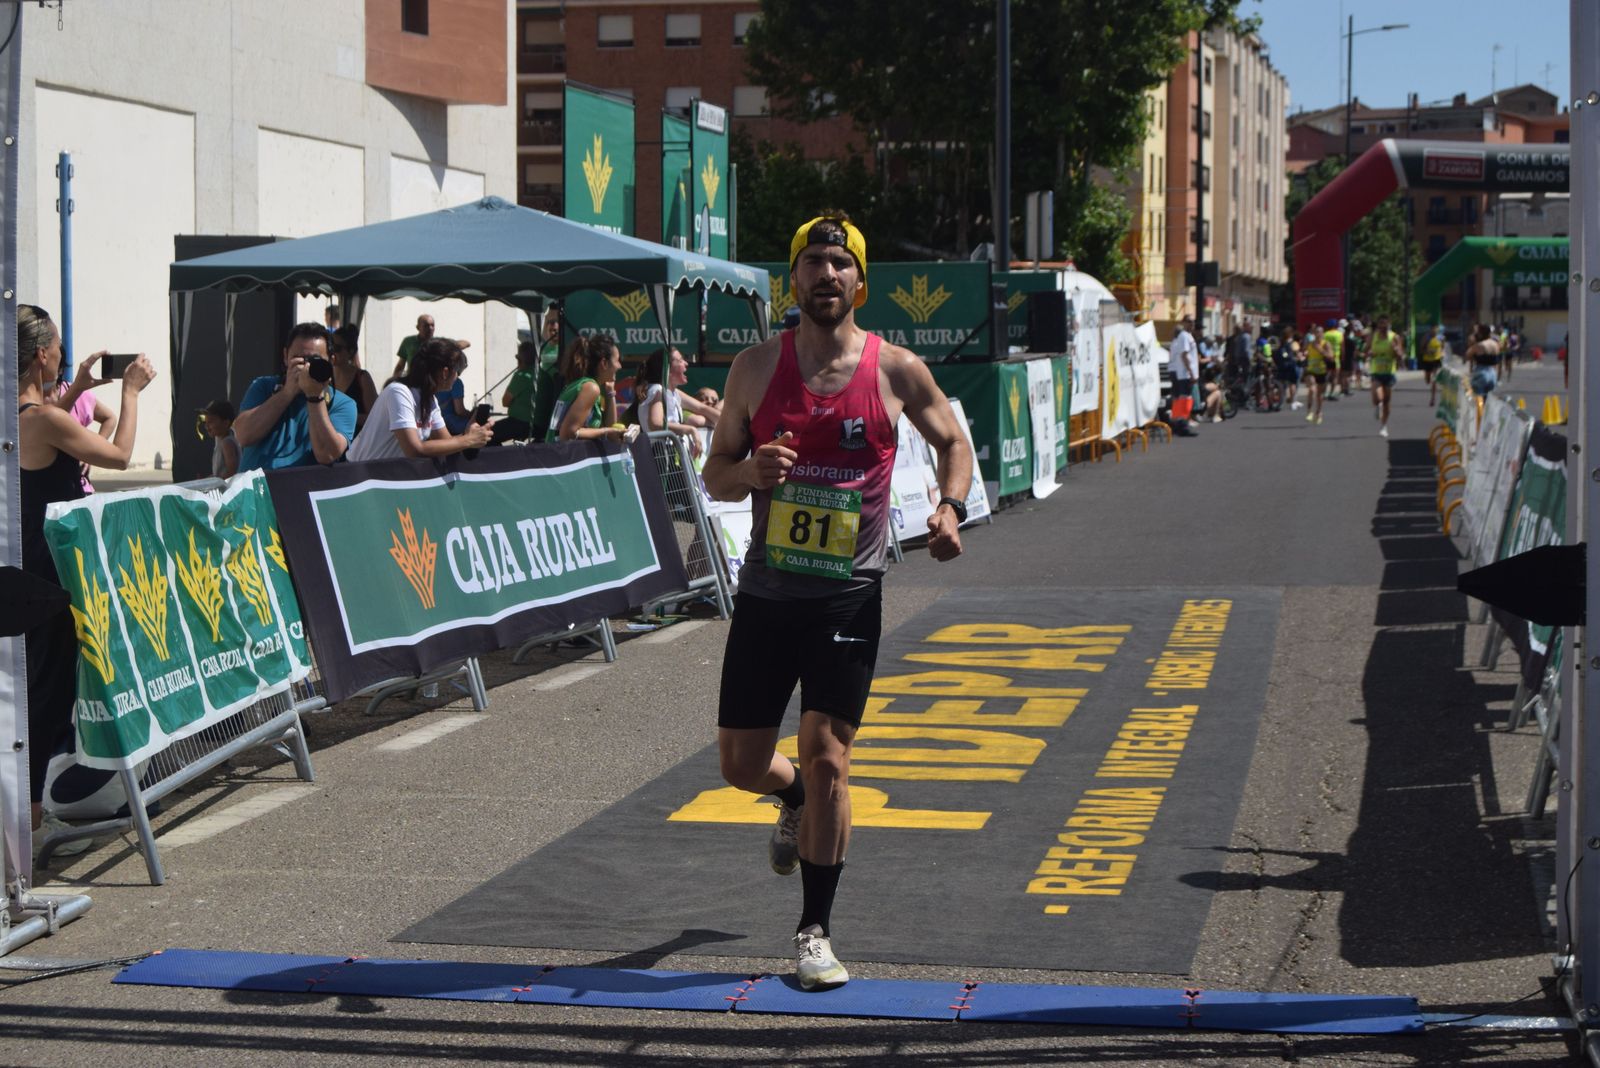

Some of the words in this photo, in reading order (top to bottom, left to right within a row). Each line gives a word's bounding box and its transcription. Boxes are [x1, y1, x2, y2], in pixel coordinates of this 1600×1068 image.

[1496, 152, 1527, 165] CON
[1531, 153, 1548, 166] EL
[1496, 169, 1565, 183] GANAMOS
[914, 328, 980, 345] RURAL
[791, 461, 866, 481] isiorama
[796, 486, 852, 502] FUNDACION
[796, 495, 817, 505] CAJA
[819, 499, 849, 510] RURAL
[789, 510, 831, 549] 81
[446, 523, 527, 594] CAJA
[516, 507, 616, 580] RURAL
[786, 554, 809, 567] CAJA
[811, 559, 847, 573] RURAL
[1144, 647, 1218, 689] DISEÑO
[164, 665, 196, 694] RURAL
[1094, 704, 1199, 779] INTEGRAL
[1025, 786, 1168, 896] REFORMA
